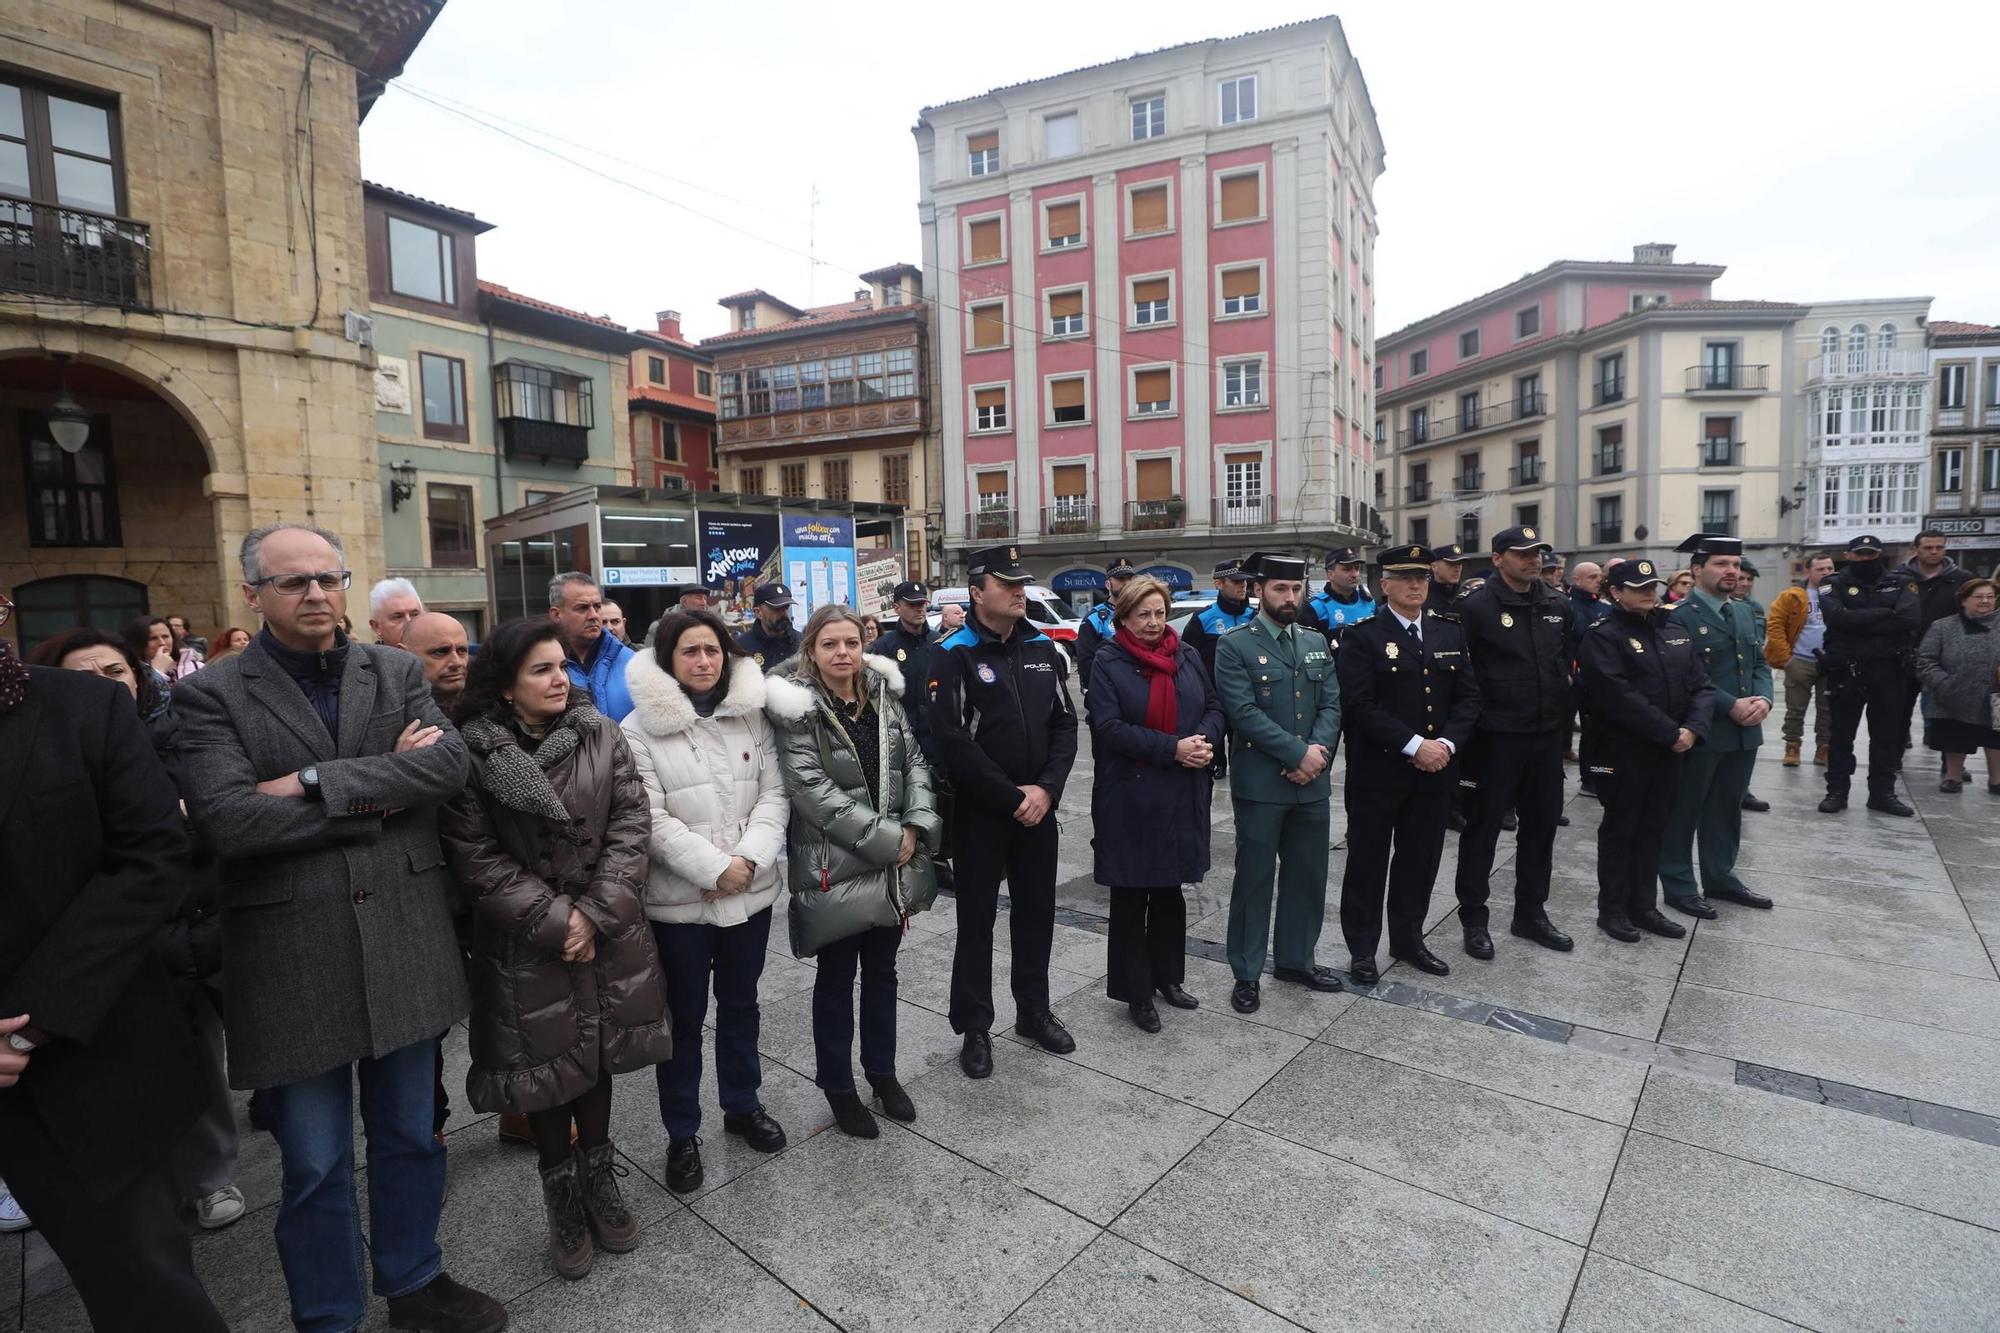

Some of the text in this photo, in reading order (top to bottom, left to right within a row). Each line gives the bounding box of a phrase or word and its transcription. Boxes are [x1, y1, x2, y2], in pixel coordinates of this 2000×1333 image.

[794, 526, 807, 534] una
[1930, 521, 1982, 532] SEIKO
[799, 533, 835, 544] mucho arte
[706, 547, 759, 582] Antroxu
